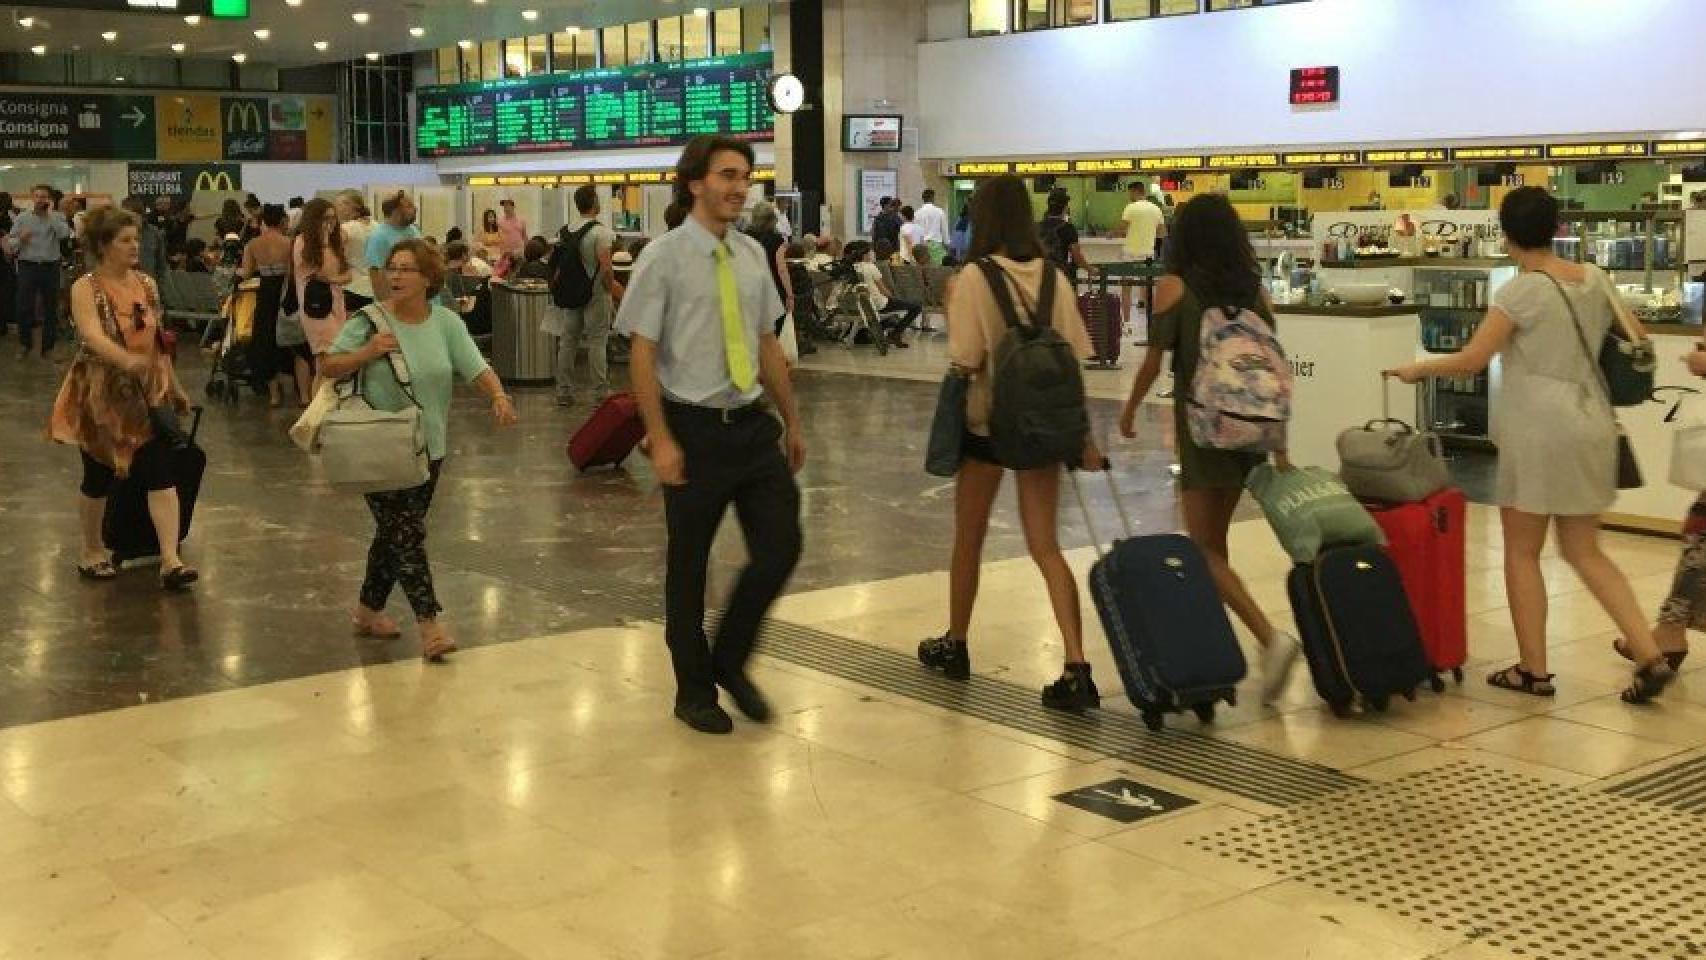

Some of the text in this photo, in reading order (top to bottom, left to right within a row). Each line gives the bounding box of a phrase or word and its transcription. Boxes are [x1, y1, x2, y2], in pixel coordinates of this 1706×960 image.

[0, 100, 68, 117] Consigna
[0, 119, 69, 137] Consigna
[129, 182, 182, 195] CAFETERIA
[1420, 218, 1502, 237] Premie
